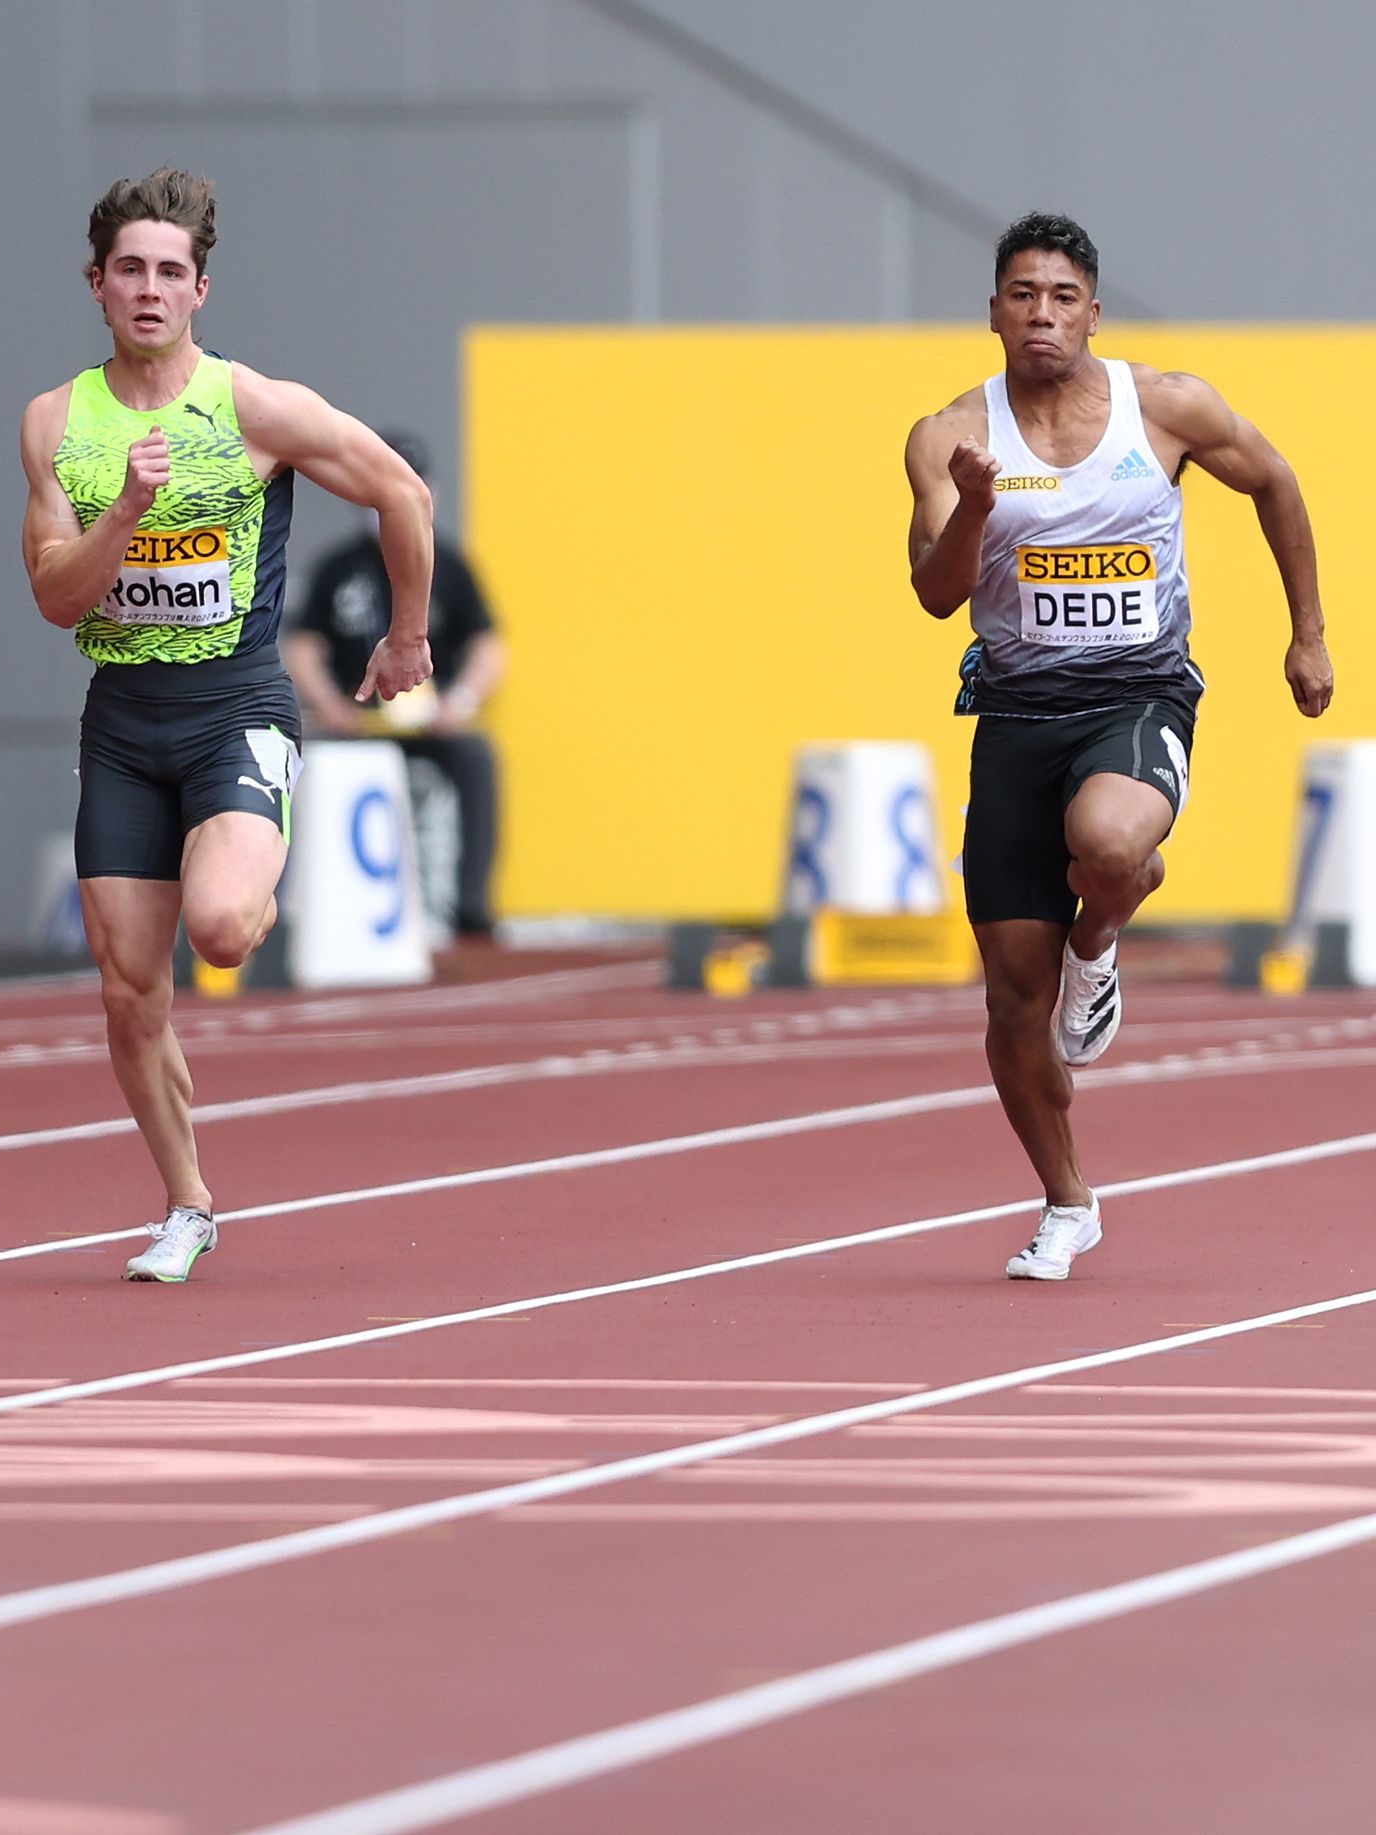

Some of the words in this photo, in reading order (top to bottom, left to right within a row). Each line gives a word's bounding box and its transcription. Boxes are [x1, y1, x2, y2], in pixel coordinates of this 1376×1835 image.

[993, 476, 1057, 492] SEIKO
[1110, 466, 1155, 482] adidas
[124, 532, 221, 563] EIKO
[1023, 549, 1151, 579] SEIKO
[1033, 590, 1142, 628] DEDE
[350, 788, 404, 937] 9
